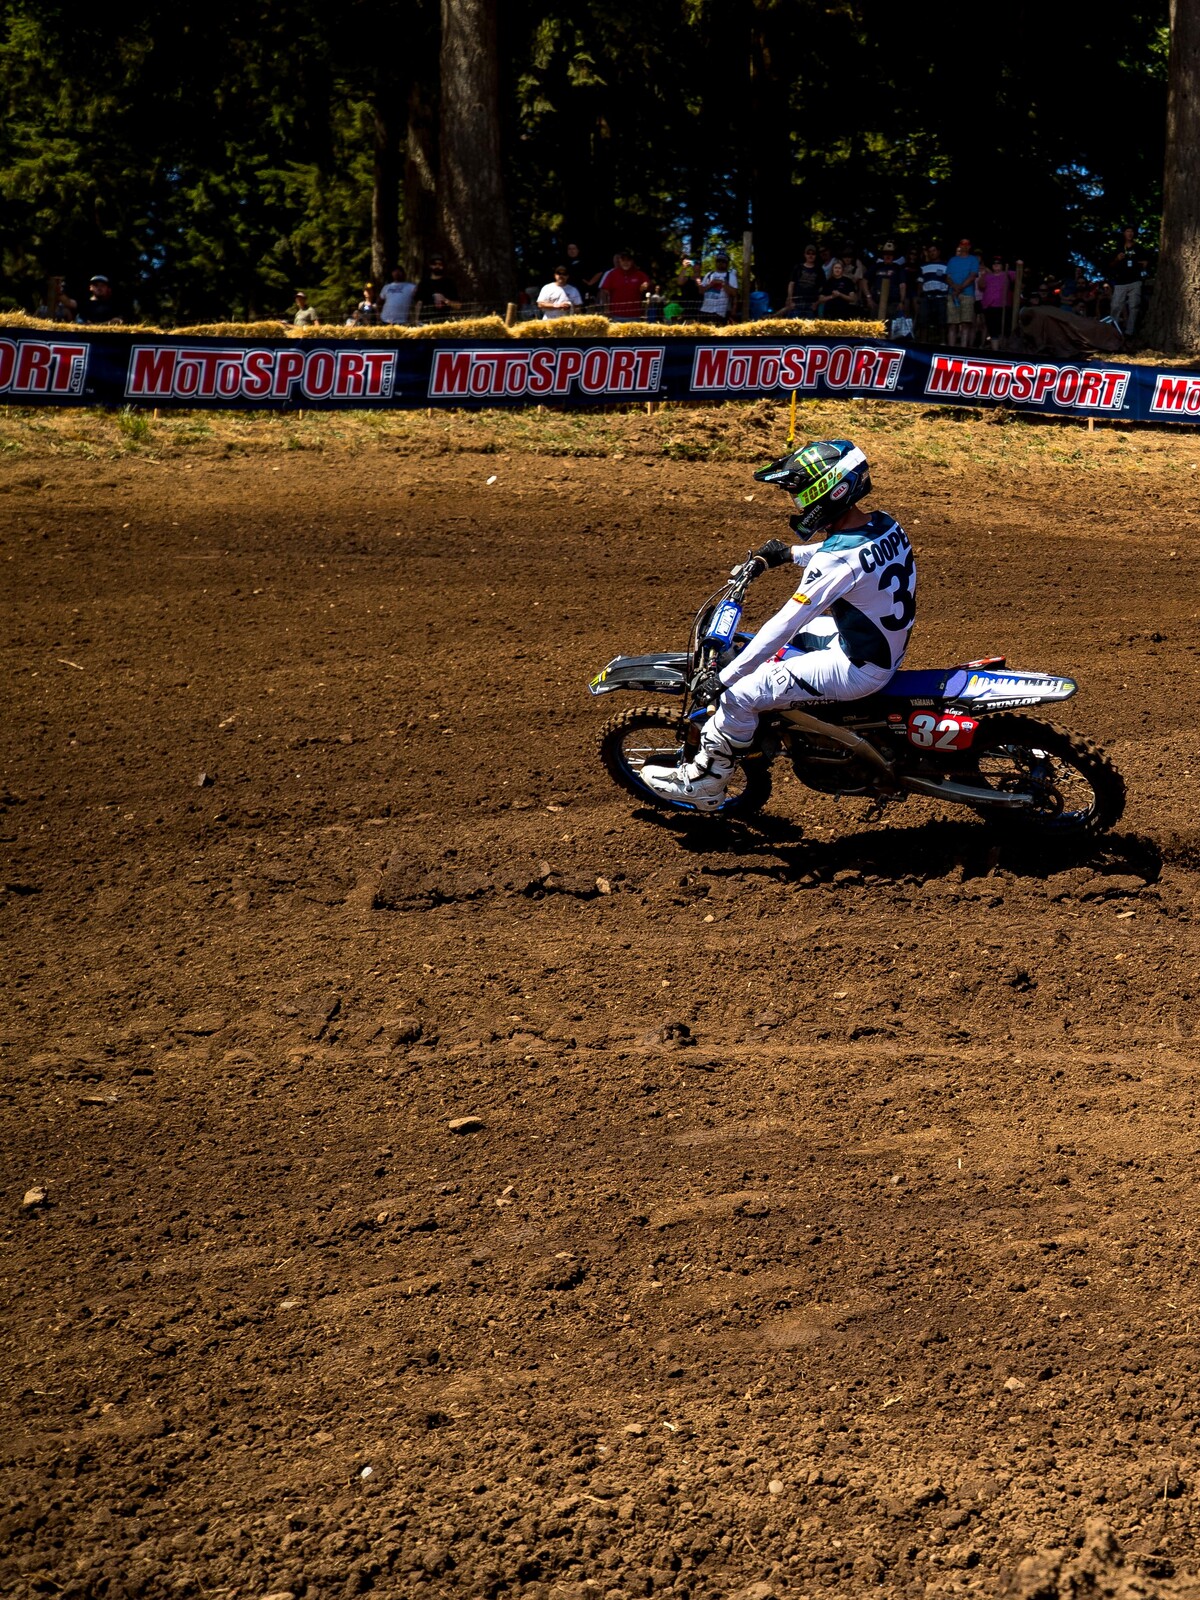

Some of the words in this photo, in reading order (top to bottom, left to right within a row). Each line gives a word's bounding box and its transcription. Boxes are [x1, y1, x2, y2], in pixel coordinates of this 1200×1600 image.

[381, 364, 393, 396] .com
[887, 361, 899, 388] .com
[802, 467, 843, 504] 100%
[832, 485, 847, 498] BELL
[909, 698, 935, 706] YAMAHA
[986, 697, 1041, 710] DUNLOP
[911, 714, 960, 751] 32
